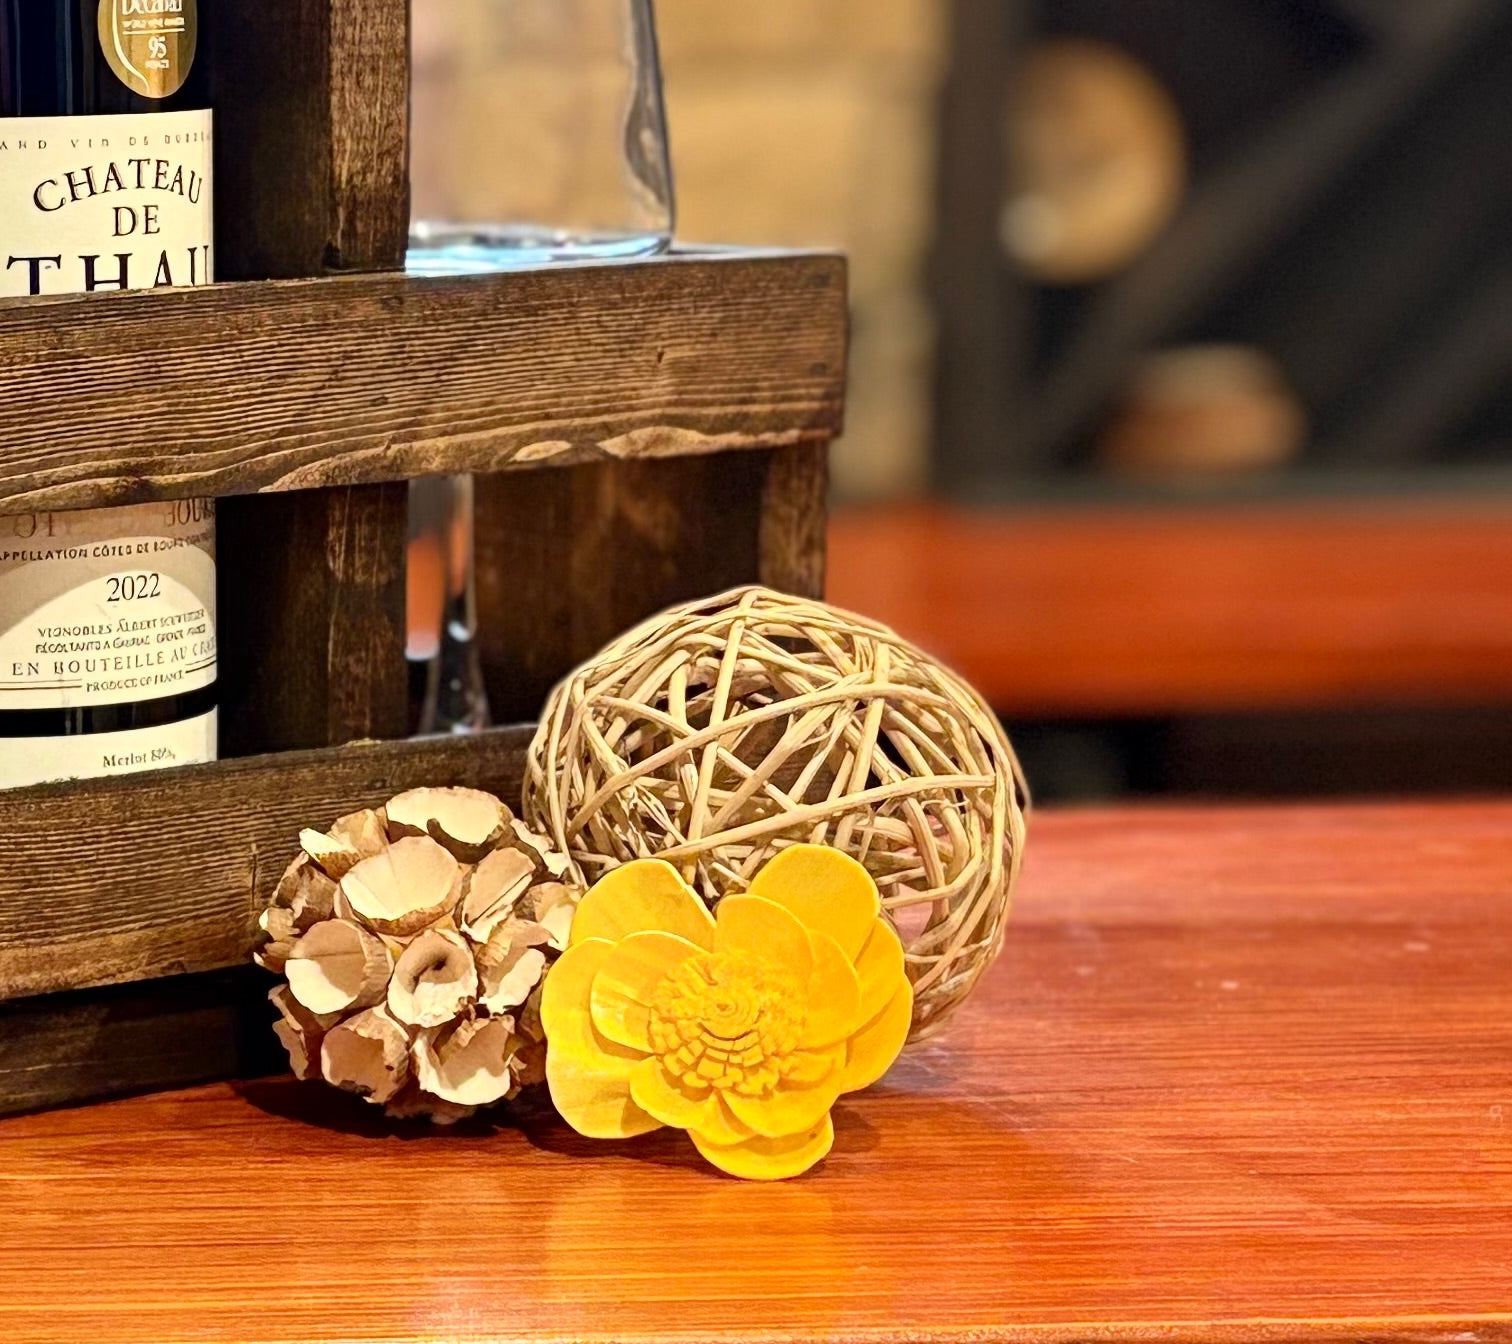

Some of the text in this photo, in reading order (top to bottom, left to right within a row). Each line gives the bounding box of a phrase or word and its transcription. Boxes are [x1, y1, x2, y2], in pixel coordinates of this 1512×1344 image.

[148, 35, 168, 59] 95
[70, 137, 110, 149] VIN
[33, 158, 203, 212] CHATEAU
[111, 204, 161, 237] DE
[106, 572, 162, 602] 2022
[38, 624, 113, 638] VIGNOBLES
[11, 662, 40, 676] EN
[54, 651, 165, 675] BOUTEILLE
[103, 752, 147, 768] Merlot
